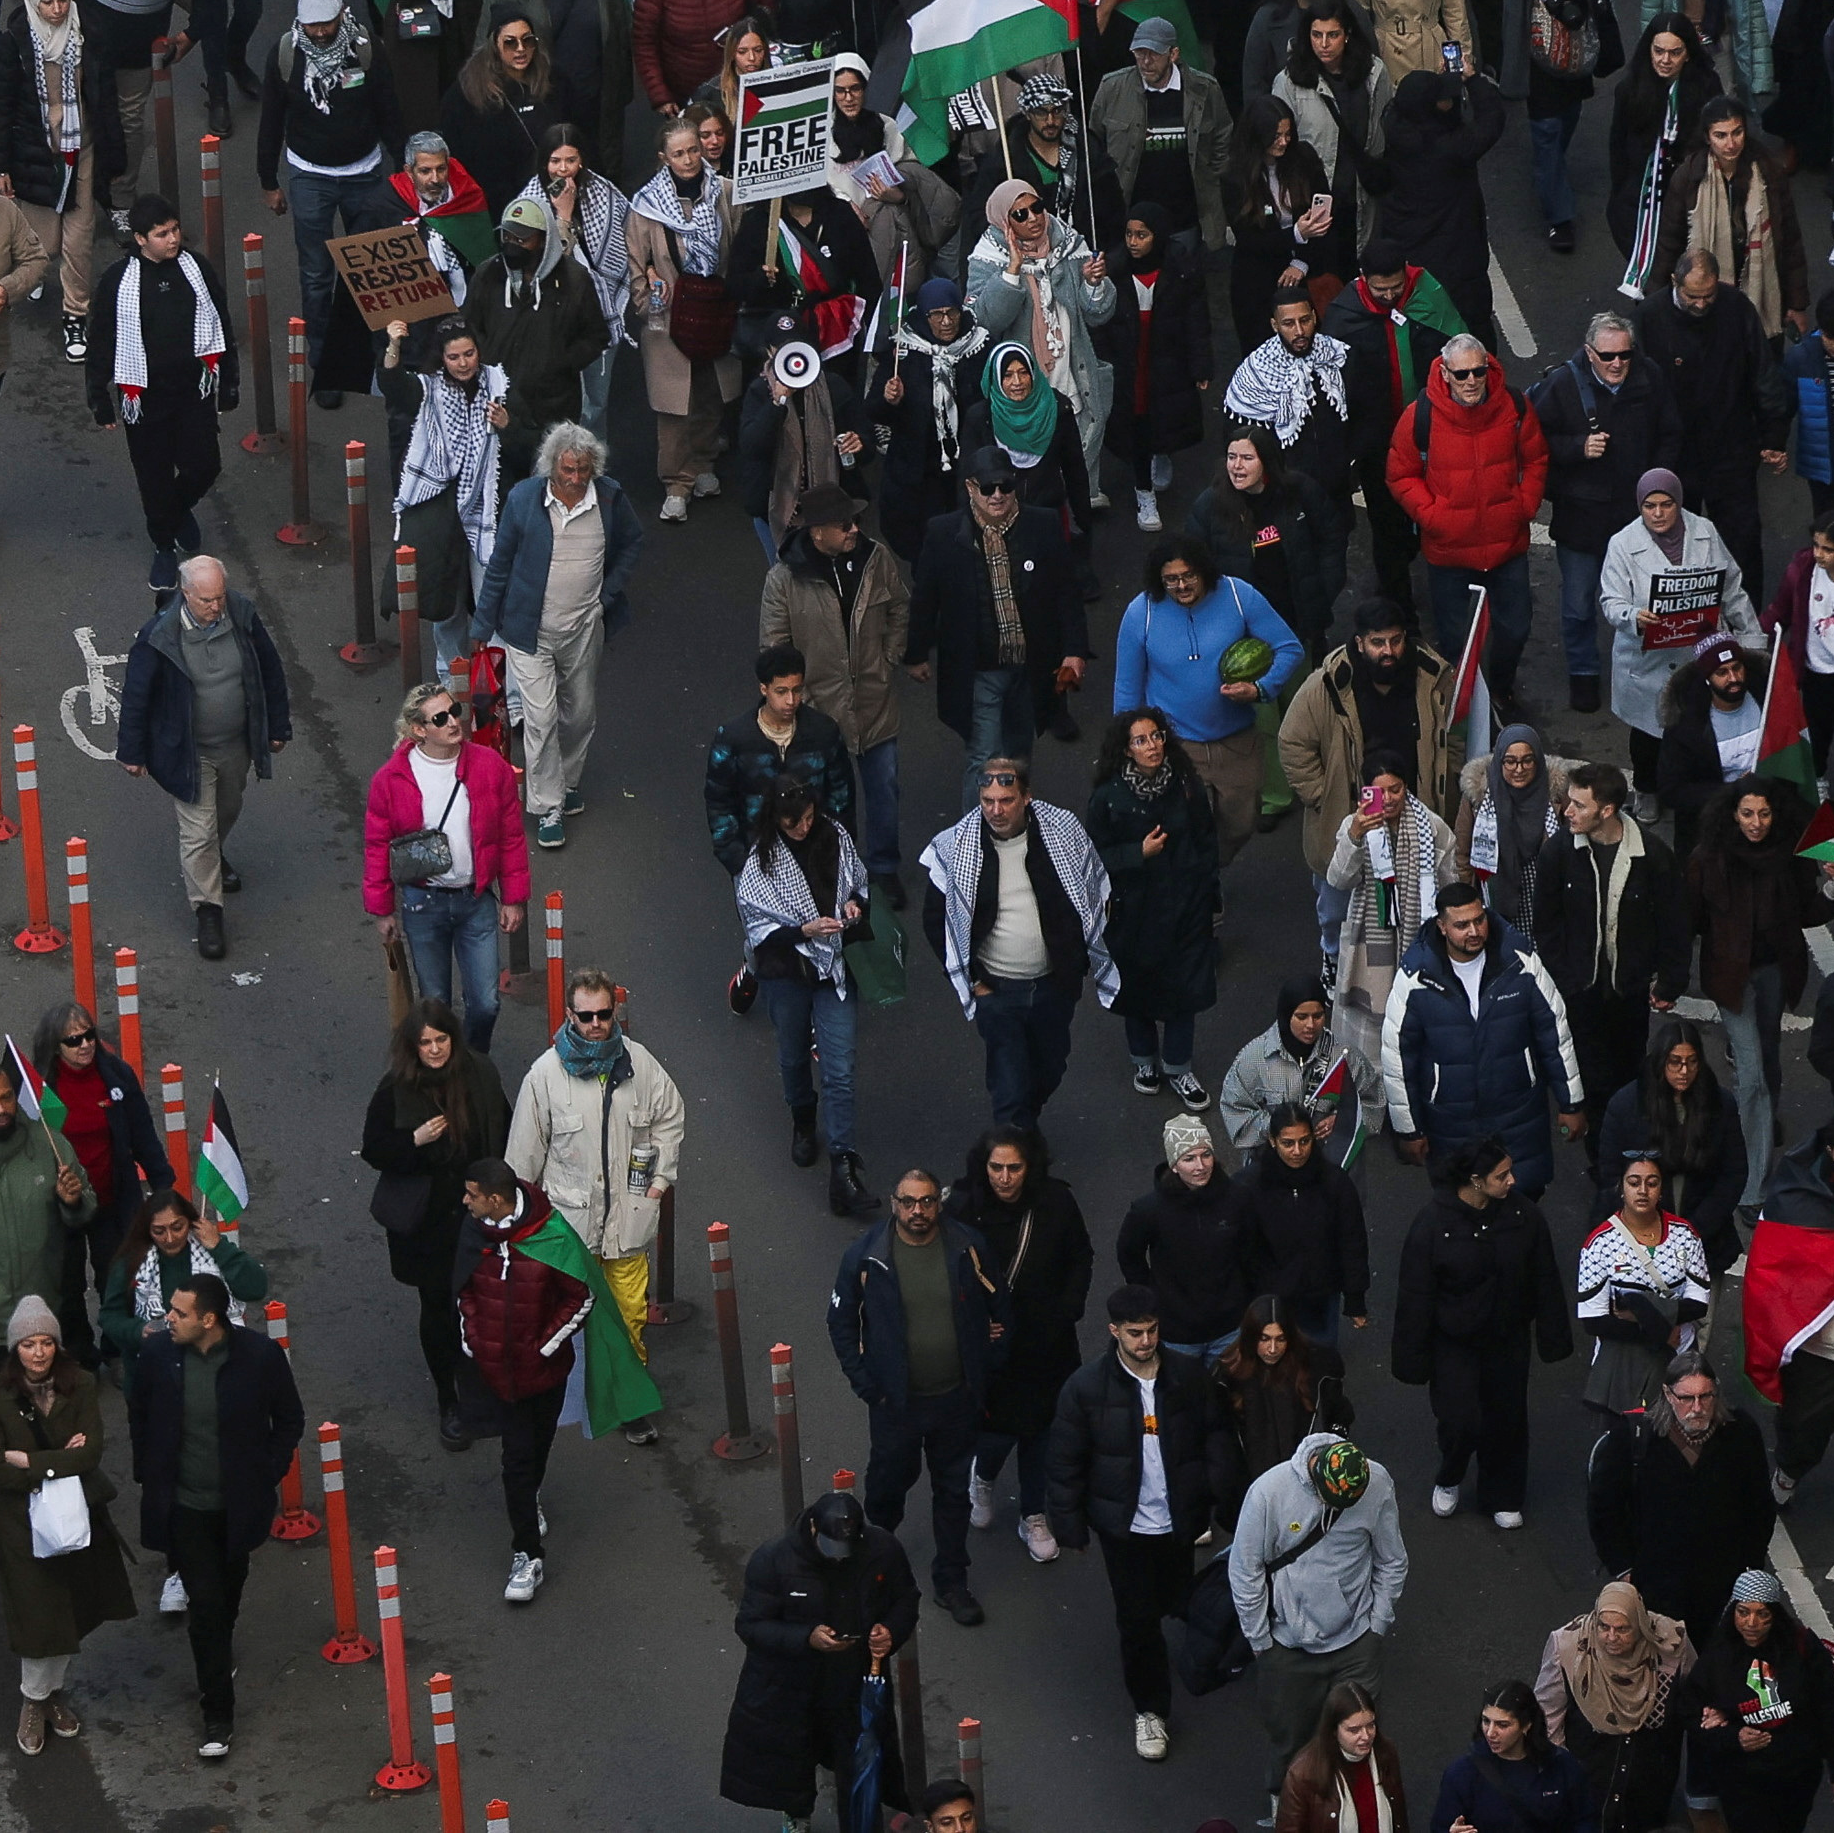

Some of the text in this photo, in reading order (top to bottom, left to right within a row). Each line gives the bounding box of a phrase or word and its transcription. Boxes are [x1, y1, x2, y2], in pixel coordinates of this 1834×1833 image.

[744, 62, 832, 85] Palestine Solidarity Campaign
[955, 92, 982, 126] EDOM
[739, 113, 828, 162] FREE
[738, 145, 826, 177] PALESTINE
[739, 162, 824, 187] END ISRAELI OCCUPATION
[340, 233, 419, 269] EXIST
[347, 258, 432, 293] RESIST
[358, 277, 449, 314] RETURN
[1664, 565, 1717, 575] Socialist Worker
[1657, 574, 1719, 594] FREEDOM
[1652, 592, 1719, 616] PALESTINE
[1661, 613, 1704, 631] الحرية
[1742, 1701, 1793, 1726] PALESTINE
